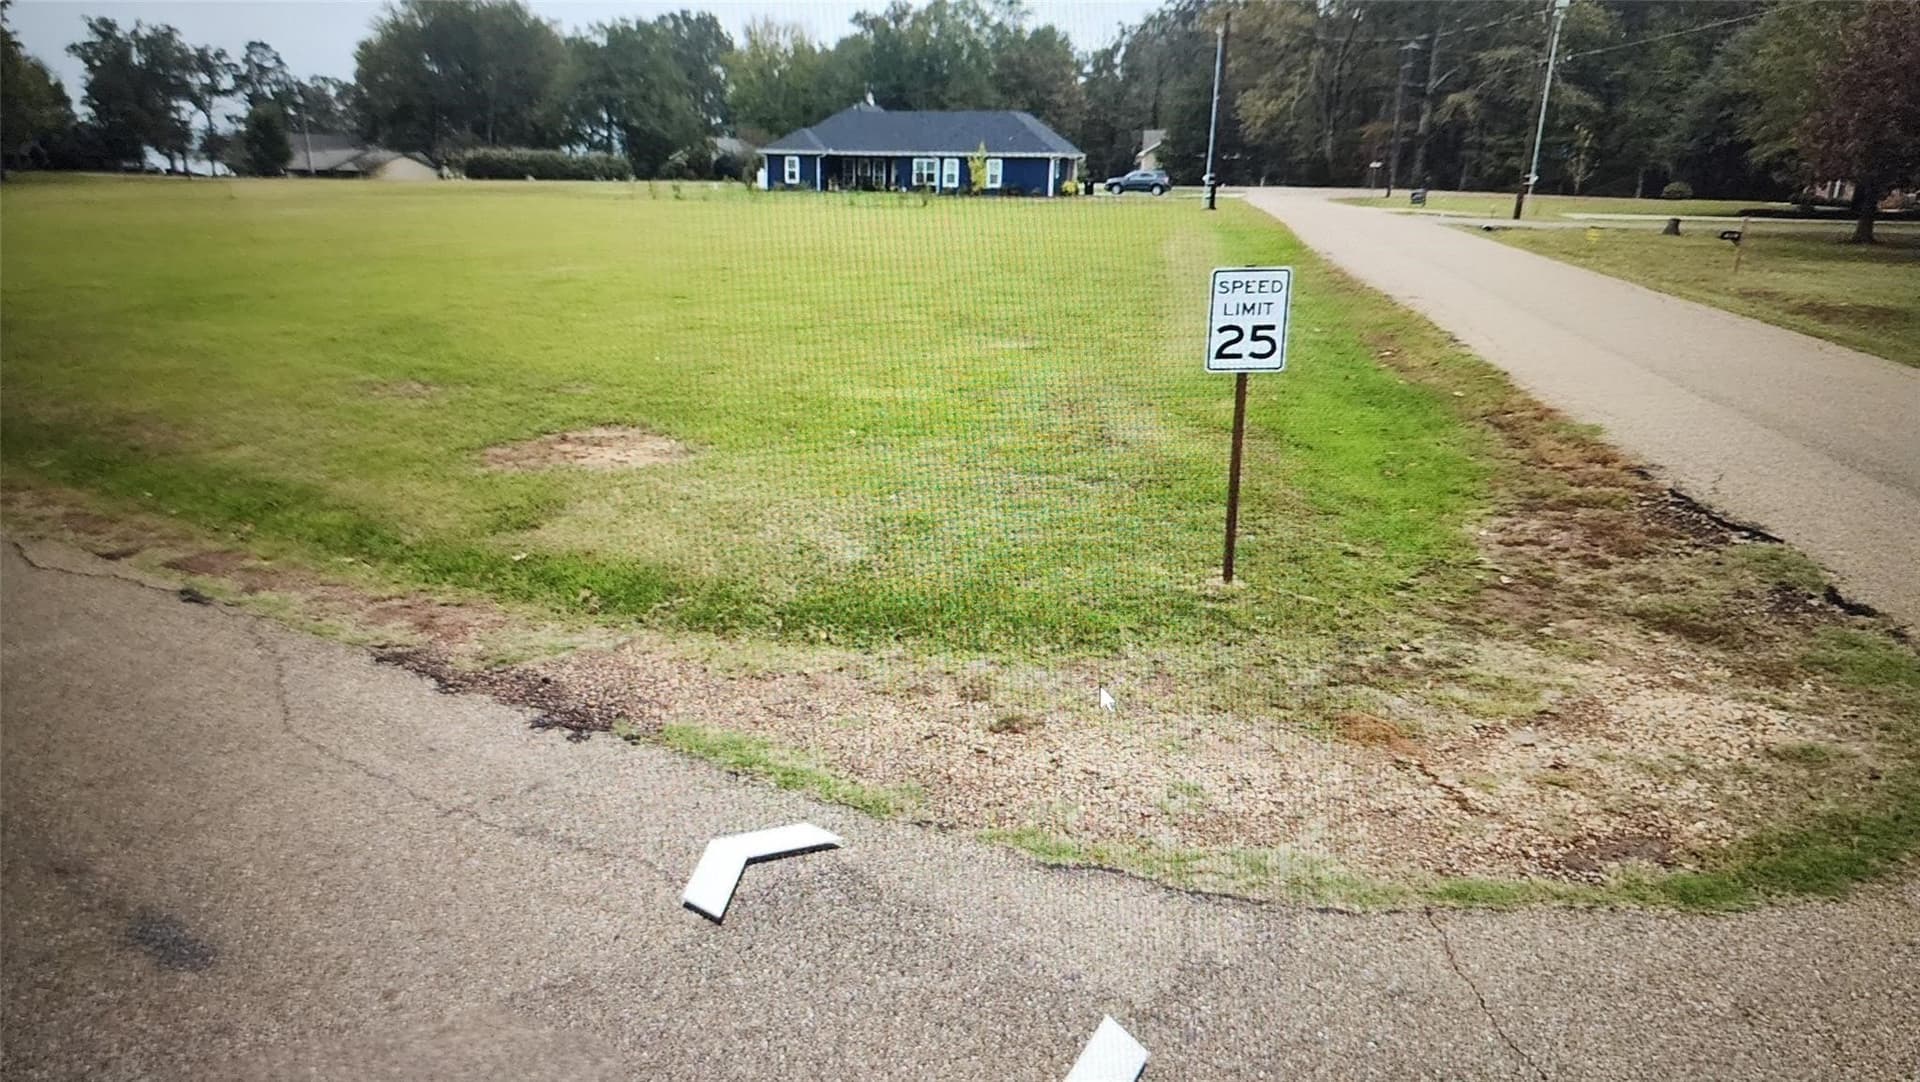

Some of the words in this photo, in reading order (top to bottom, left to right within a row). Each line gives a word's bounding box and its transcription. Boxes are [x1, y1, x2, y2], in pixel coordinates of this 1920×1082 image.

[1218, 280, 1283, 294] SPEED
[1223, 302, 1274, 316] LIMIT
[1214, 324, 1277, 360] 25
